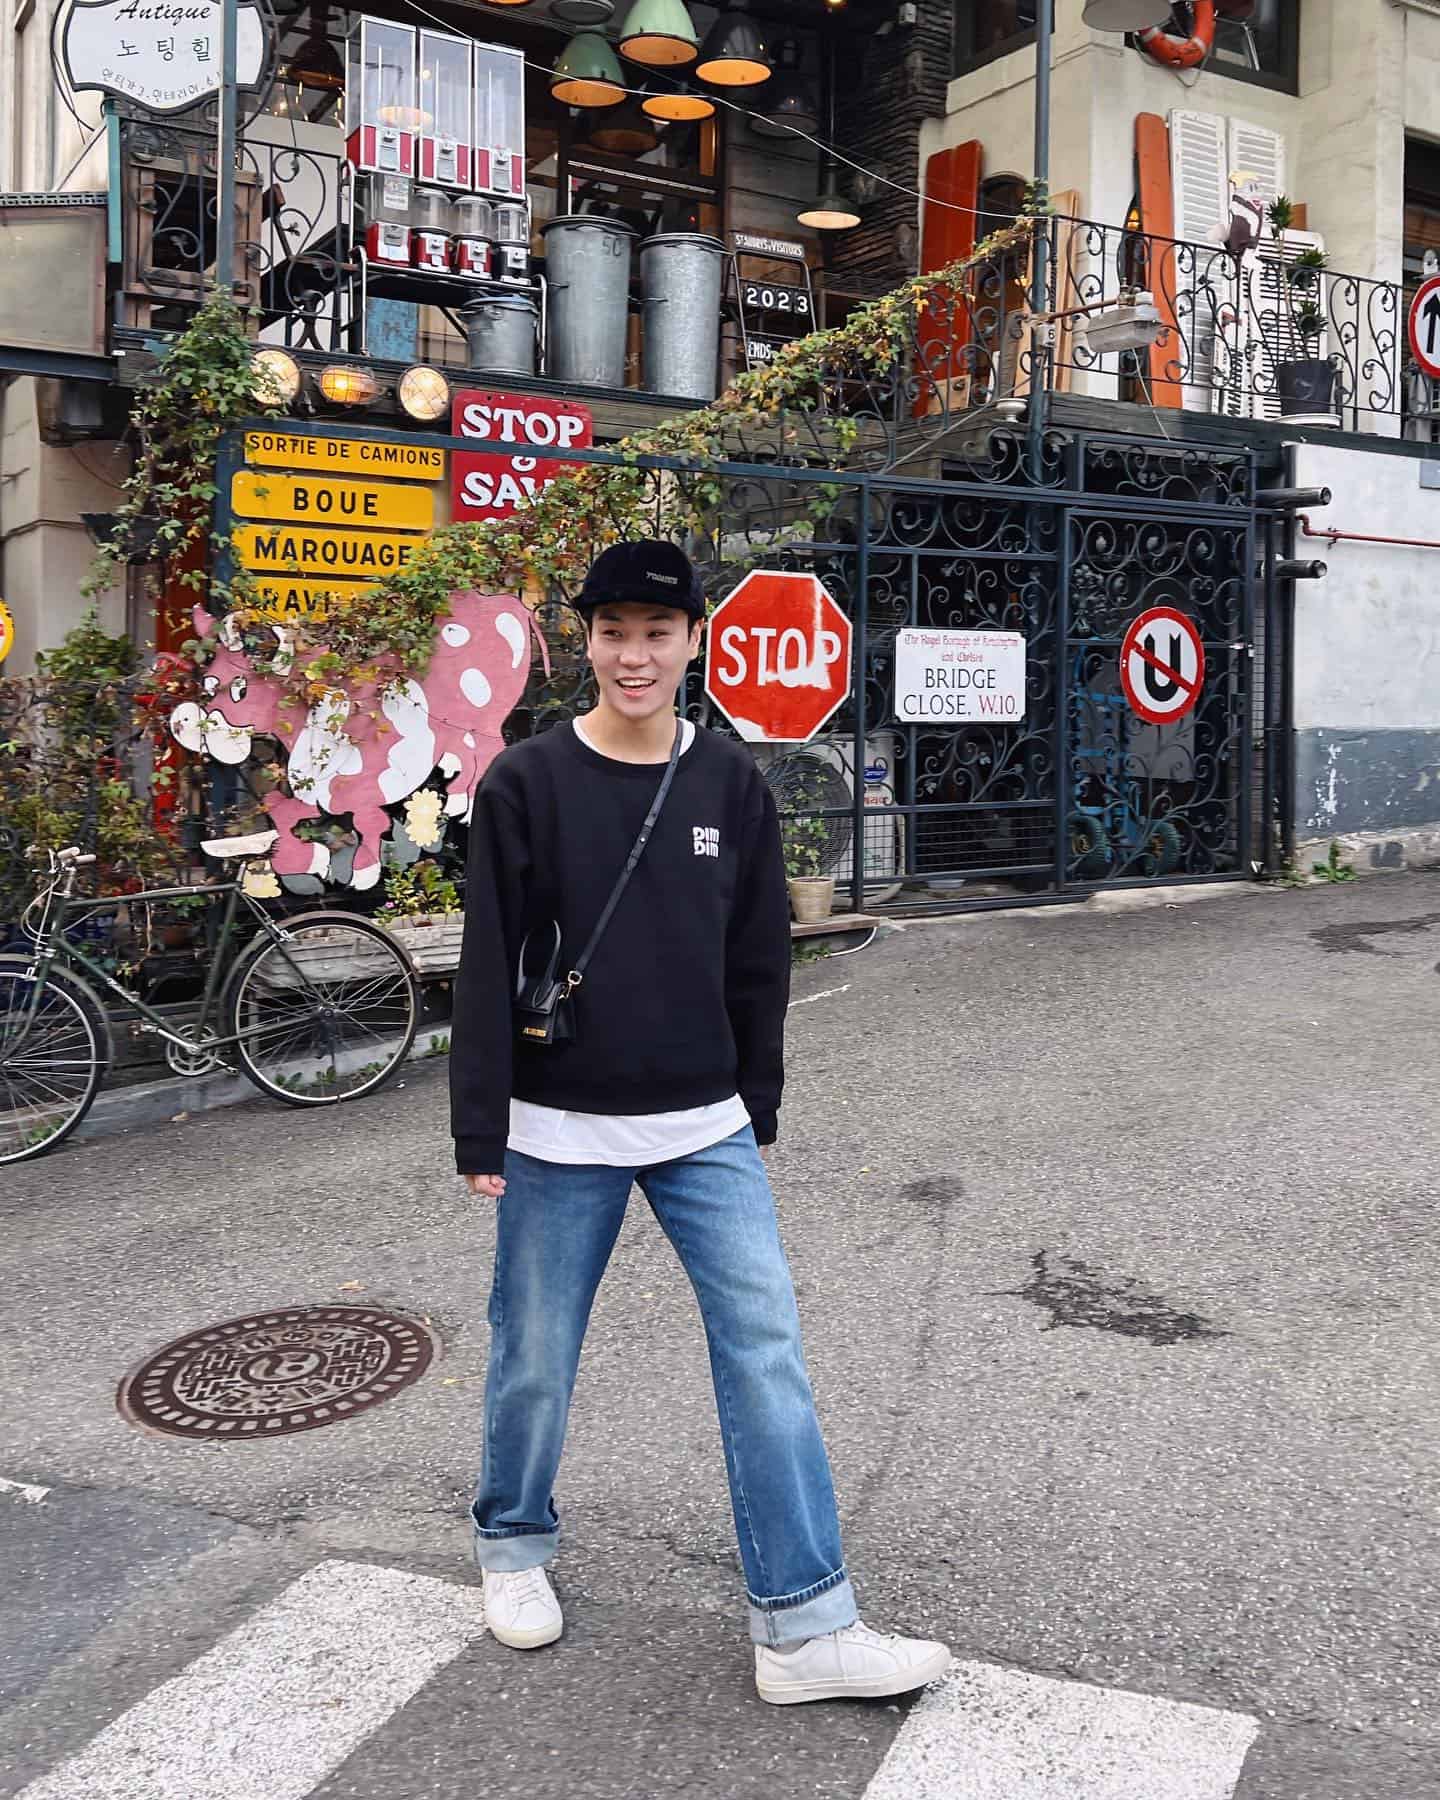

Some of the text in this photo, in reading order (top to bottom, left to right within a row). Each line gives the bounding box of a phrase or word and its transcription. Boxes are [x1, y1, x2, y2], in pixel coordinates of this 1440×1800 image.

[115, 0, 212, 26] Antique
[117, 36, 211, 62] 노팅힐
[747, 287, 808, 313] 2023
[460, 404, 584, 448] STOP
[249, 434, 441, 466] SORTIE DE CAMIONS
[293, 487, 378, 516] BOUE
[460, 471, 557, 508] SAV
[255, 535, 412, 566] MARQUAGE
[717, 625, 842, 689] STOP
[925, 667, 996, 689] BRIDGE
[903, 694, 971, 715] CLOSE.
